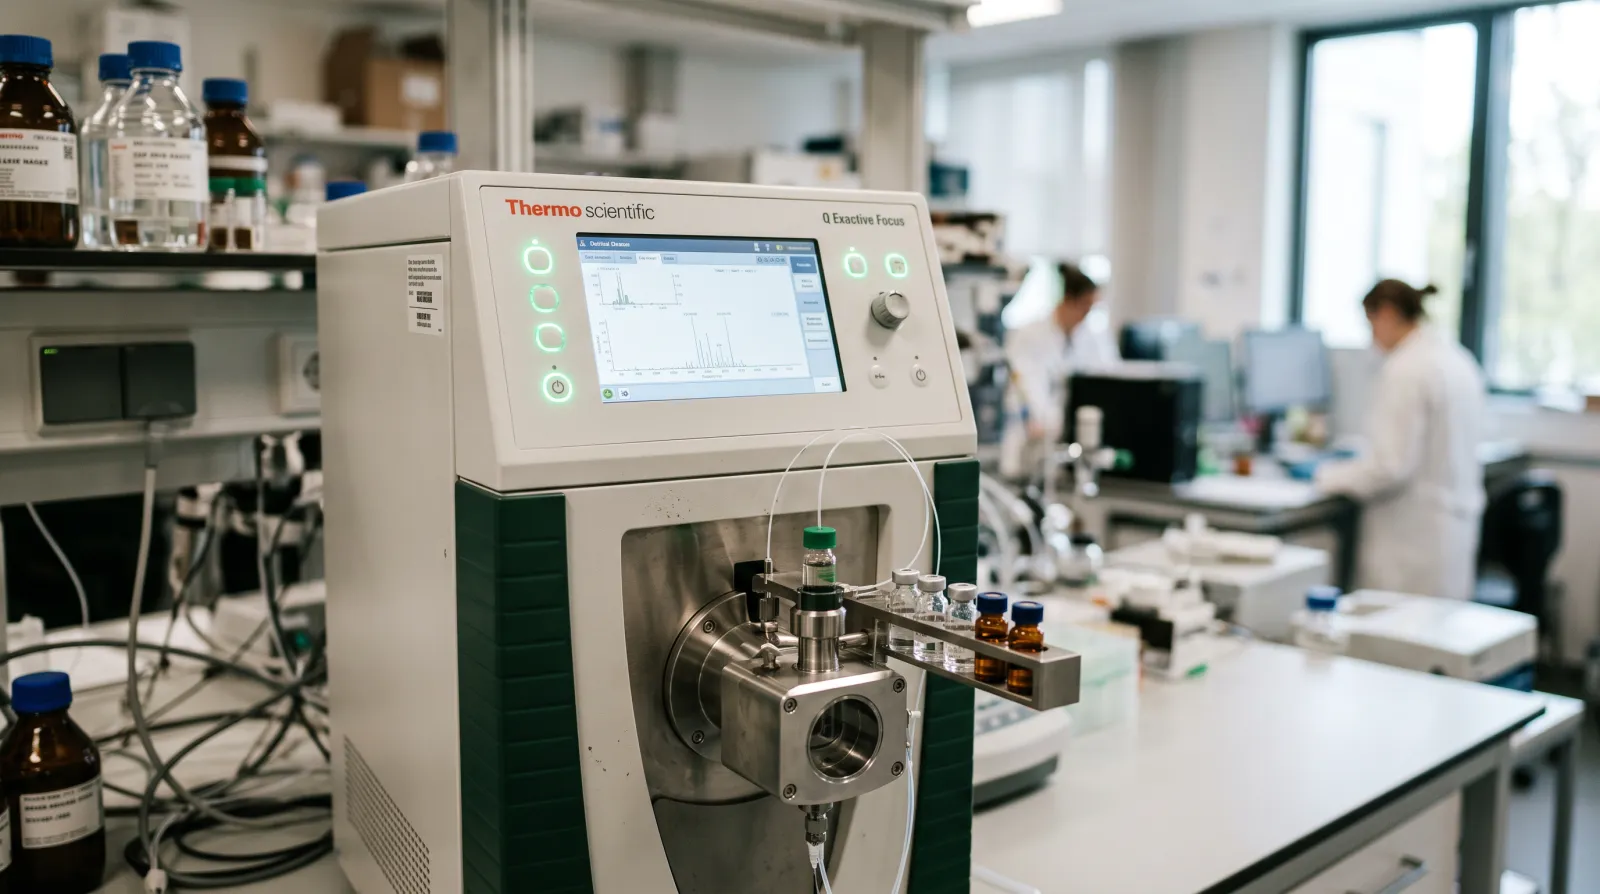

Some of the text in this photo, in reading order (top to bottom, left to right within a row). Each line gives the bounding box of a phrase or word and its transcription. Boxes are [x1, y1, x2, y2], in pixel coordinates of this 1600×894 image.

[505, 199, 655, 220] Thermo scientific
[822, 212, 905, 226] Q Exactive Focus
